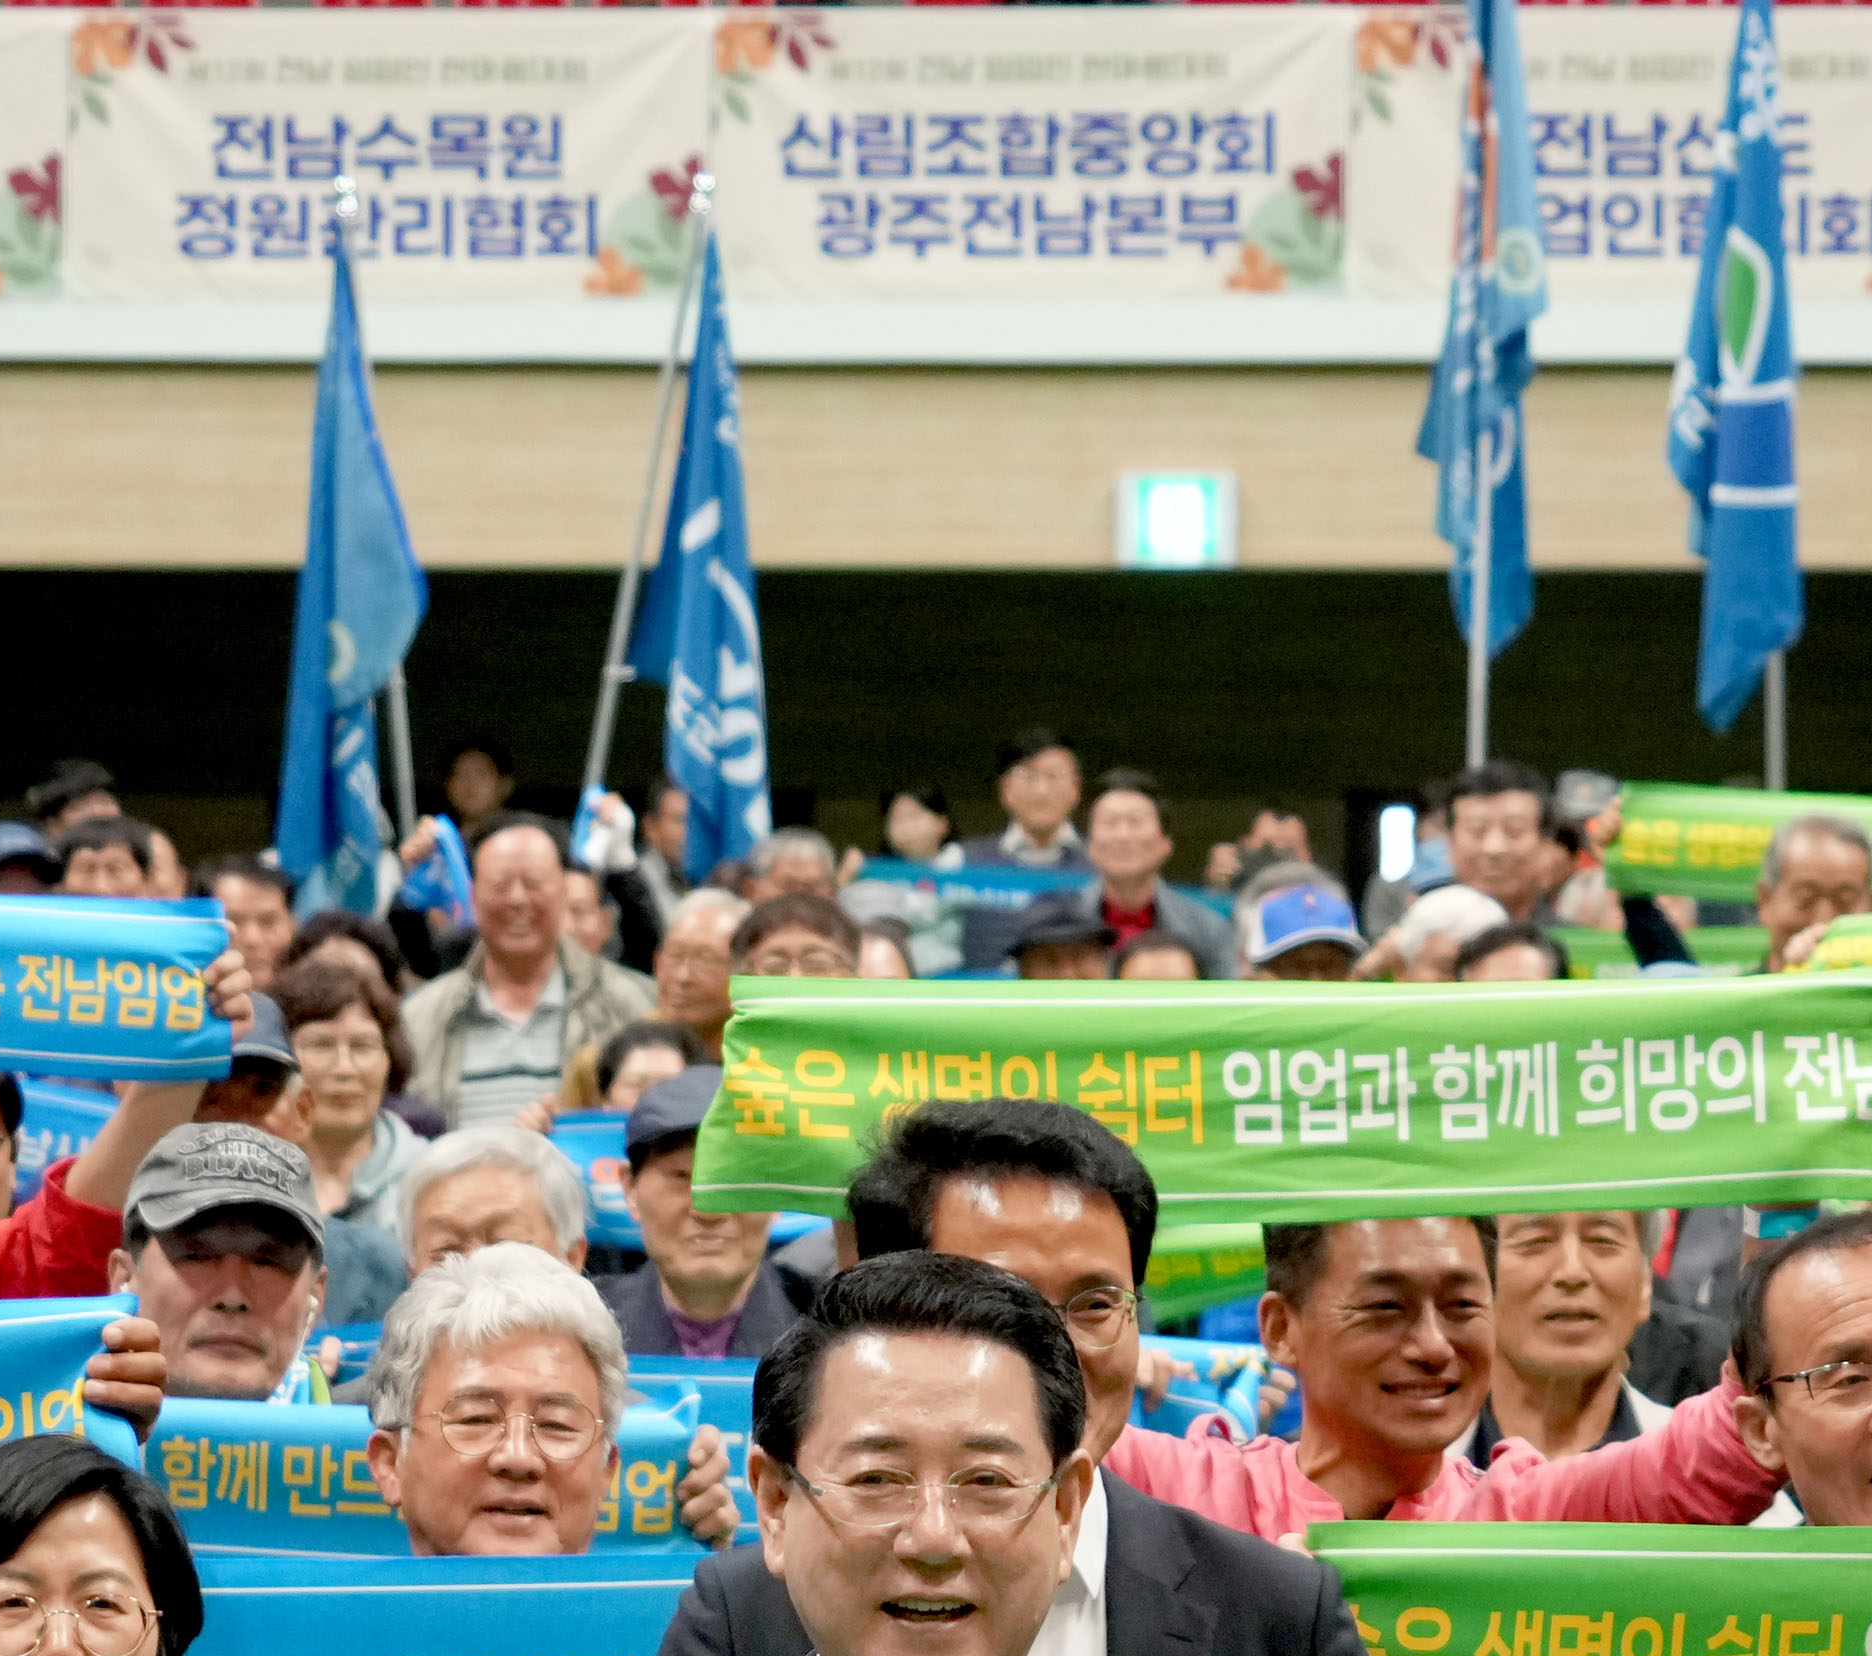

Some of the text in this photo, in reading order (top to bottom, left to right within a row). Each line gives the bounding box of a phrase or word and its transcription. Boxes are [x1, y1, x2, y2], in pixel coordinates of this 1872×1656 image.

[213, 114, 564, 180] 전남수목원
[780, 111, 1277, 178] 산림조합중앙회
[817, 191, 1246, 257] 광주전남본부
[16, 954, 207, 1032] 전남임업
[725, 1046, 857, 1139] 숲은
[1077, 1049, 1206, 1145] 쉼터
[1221, 1046, 1417, 1146] 임업과
[1429, 1042, 1561, 1139] 함께
[1576, 1029, 1769, 1134] 희망의
[159, 1434, 270, 1512] 함께
[284, 1436, 408, 1520] 만드
